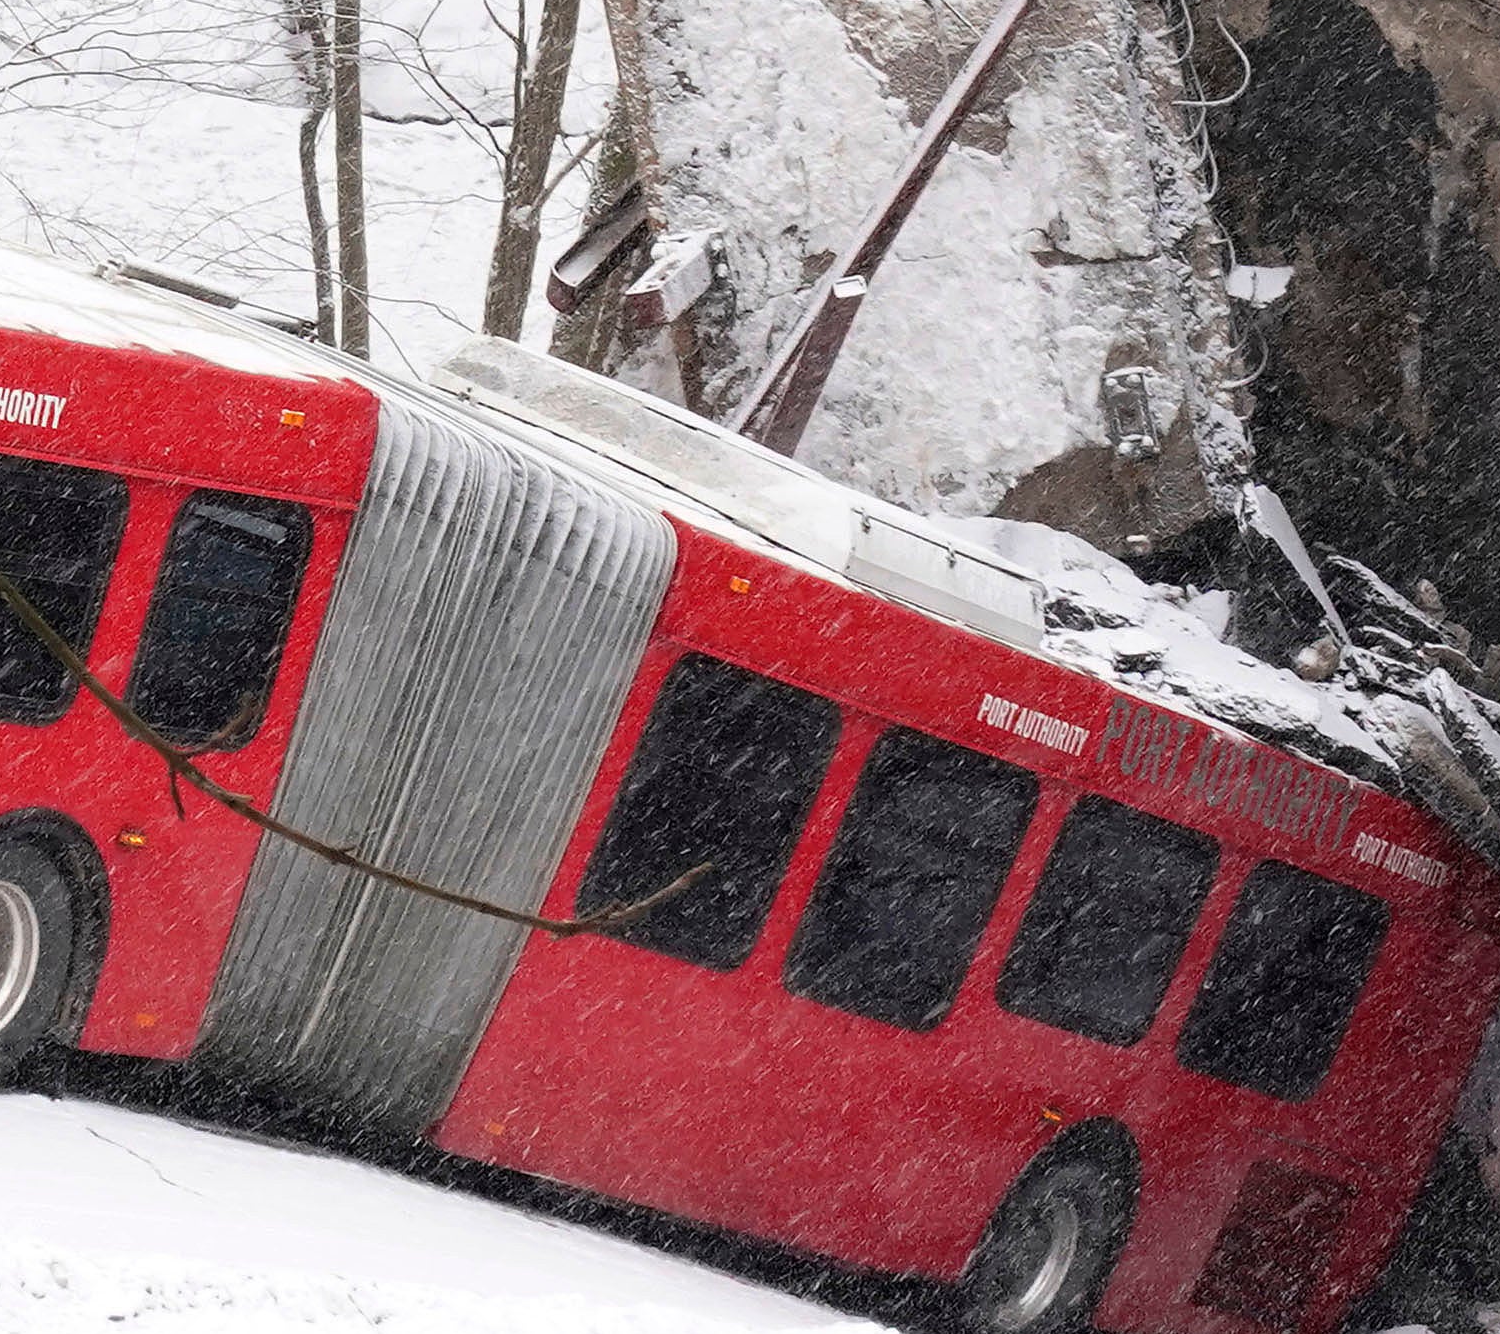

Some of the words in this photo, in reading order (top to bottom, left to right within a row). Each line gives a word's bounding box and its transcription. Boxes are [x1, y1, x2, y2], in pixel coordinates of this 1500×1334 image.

[976, 693, 1019, 731] PORT
[1012, 708, 1090, 756] AUTHORITY
[1095, 697, 1194, 790] PORT
[1183, 733, 1361, 851] AUTHORITY
[1351, 832, 1389, 868] PORT
[1382, 844, 1448, 888] AUTHORITY
